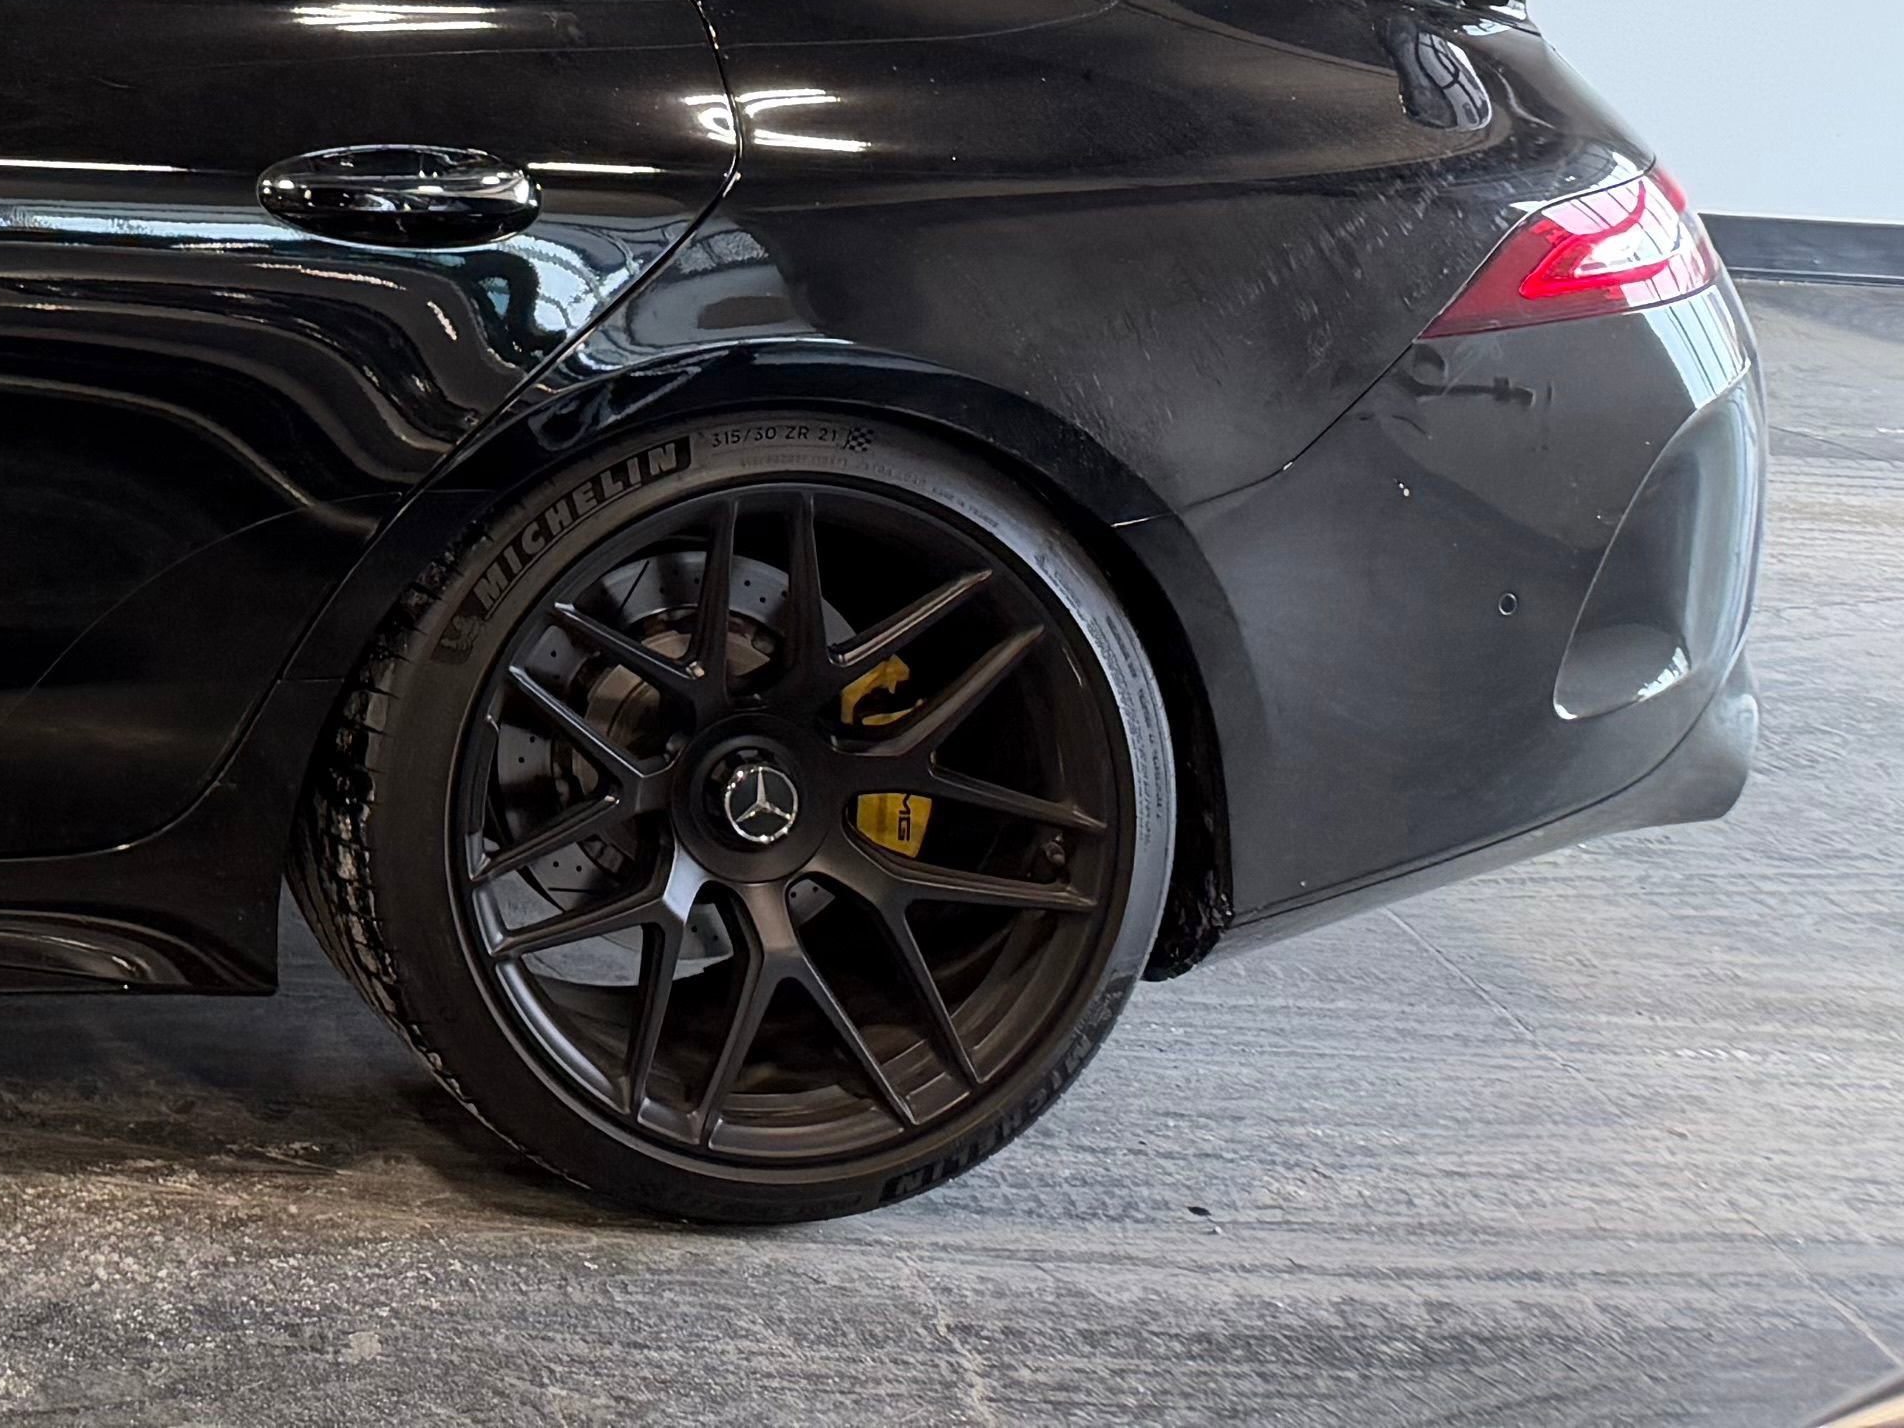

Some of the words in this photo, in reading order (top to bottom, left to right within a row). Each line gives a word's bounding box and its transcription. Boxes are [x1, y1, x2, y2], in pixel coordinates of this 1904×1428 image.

[711, 425, 777, 449] 315/30
[784, 425, 810, 441] ZR
[818, 427, 837, 442] 21
[472, 442, 678, 612] MICHELIN
